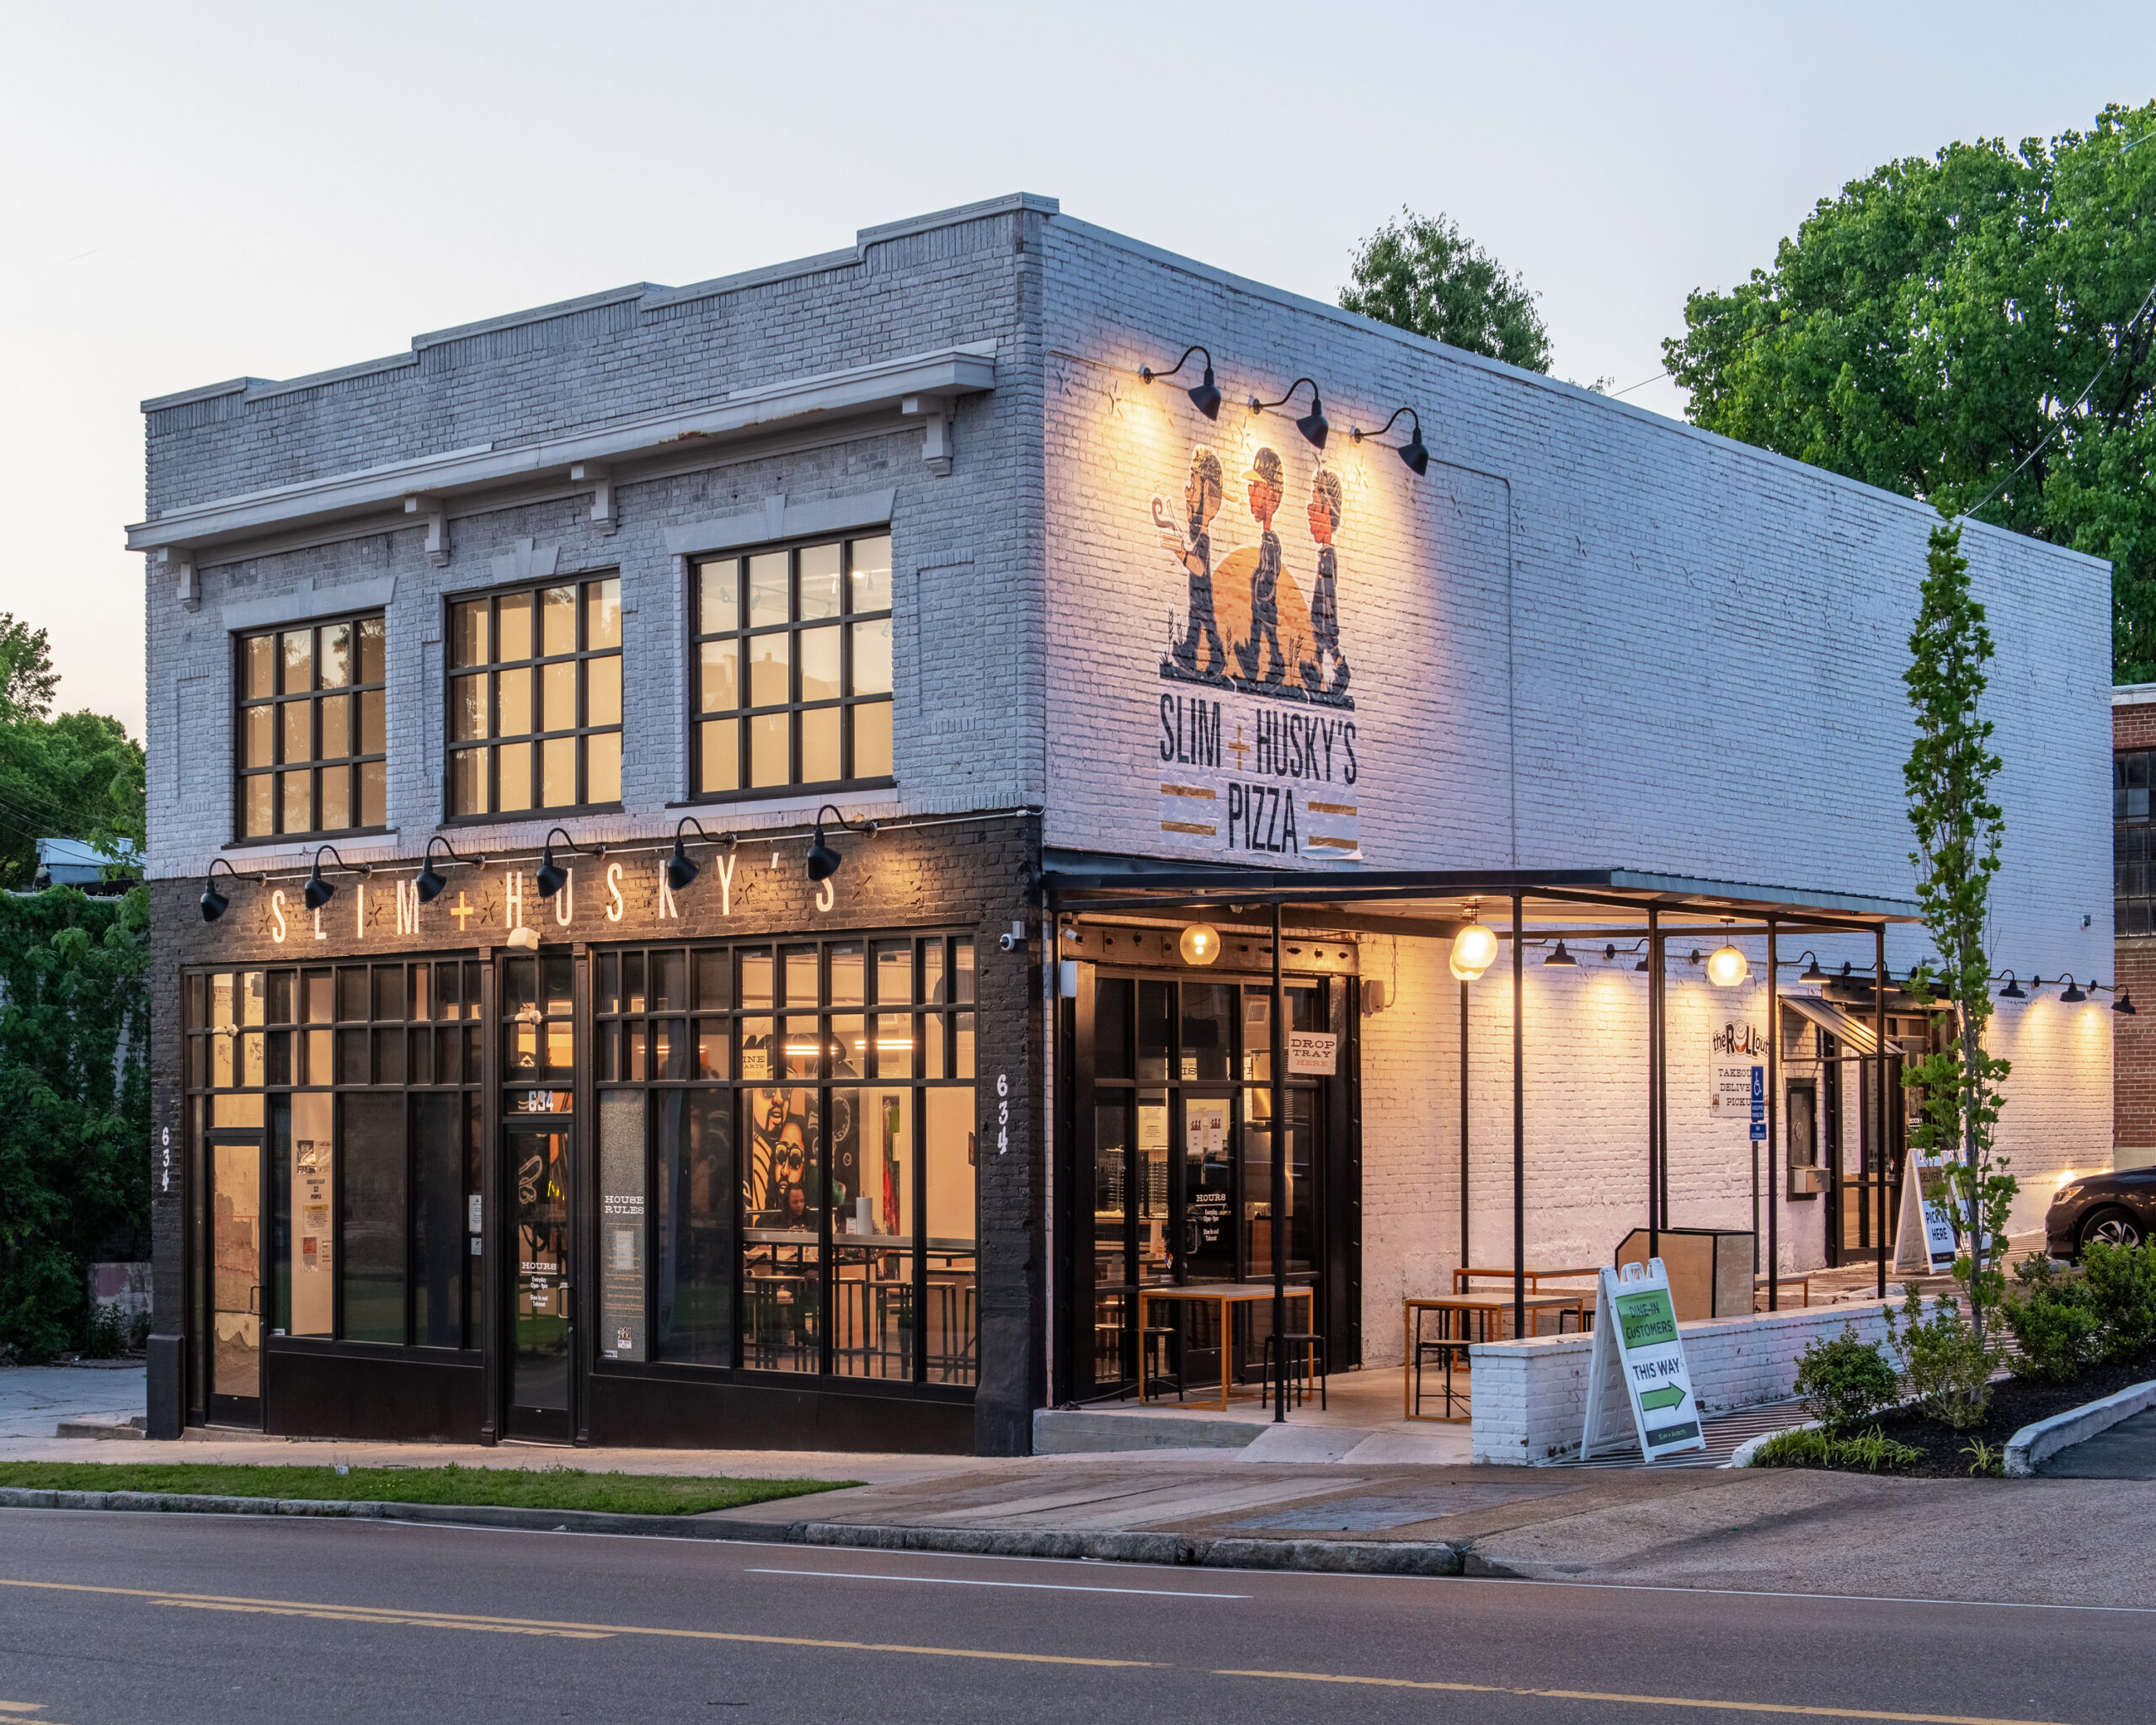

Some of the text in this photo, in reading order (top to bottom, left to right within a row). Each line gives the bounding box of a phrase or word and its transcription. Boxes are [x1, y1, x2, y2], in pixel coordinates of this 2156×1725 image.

[1160, 693, 1357, 786] SLIM + HUSKY'S
[1229, 782, 1299, 854] PIZZA
[271, 879, 419, 943] SLIM
[505, 852, 835, 930] HUSKY'S
[1290, 1039, 1335, 1049] DROP
[1293, 1049, 1331, 1058] TRAY
[1296, 1059, 1328, 1067] HERE
[1718, 1068, 1751, 1076] TAKEOU
[1720, 1083, 1751, 1092] DELIVE
[528, 1090, 554, 1112] 634
[1726, 1097, 1751, 1106] PICKU
[995, 1074, 1009, 1155] 634
[162, 1126, 170, 1193] 634
[605, 1195, 644, 1204] HOUSE
[1196, 1194, 1226, 1202] HOURS
[604, 1205, 645, 1215] RULES
[1925, 1211, 1940, 1225] PICK
[1931, 1228, 1948, 1241] HERE
[521, 1262, 557, 1270] HOURS
[1629, 1301, 1660, 1318] DINE-IN
[1625, 1320, 1673, 1340] CUSTOMERS
[1632, 1358, 1681, 1381] THIS WAY
